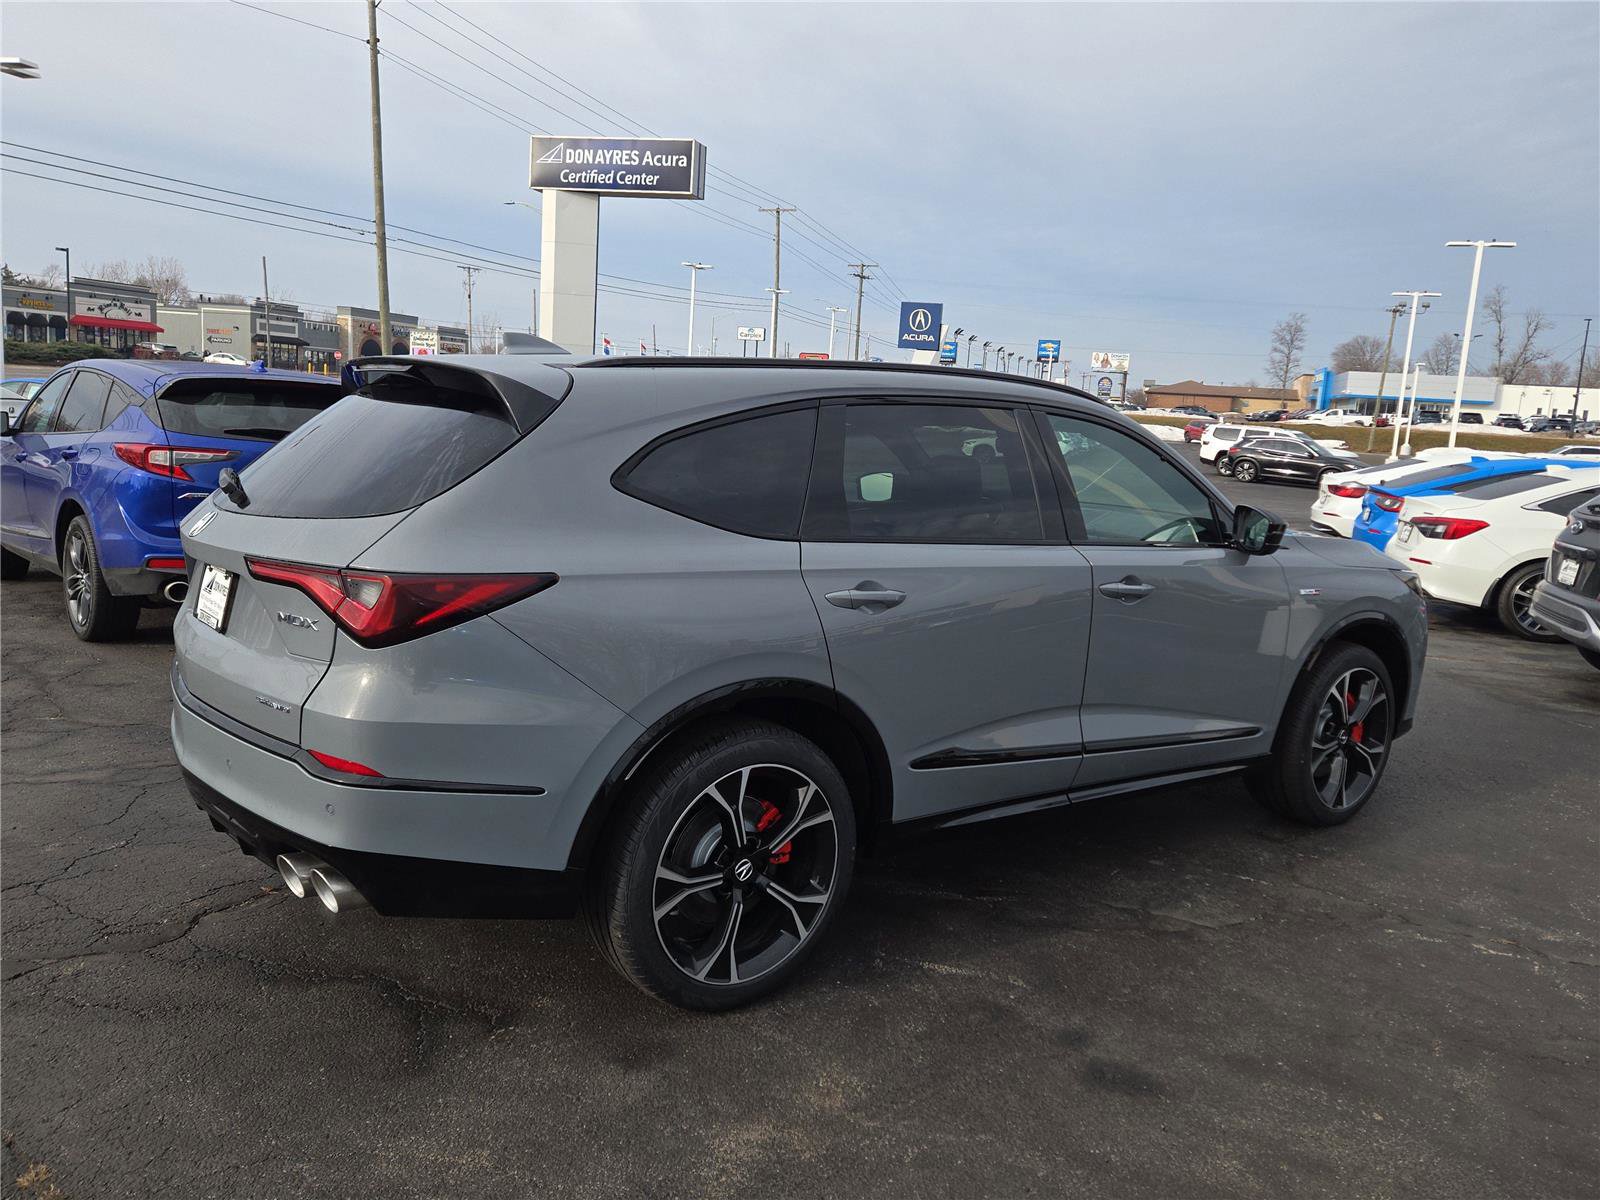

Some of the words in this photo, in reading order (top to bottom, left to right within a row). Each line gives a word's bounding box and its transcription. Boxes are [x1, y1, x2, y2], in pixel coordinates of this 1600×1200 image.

[566, 148, 593, 164] DON
[595, 149, 639, 166] AYRES
[642, 150, 687, 167] Acura
[560, 169, 613, 184] Certified
[616, 171, 659, 186] Center
[902, 333, 935, 341] ACURA
[277, 611, 320, 631] MDX
